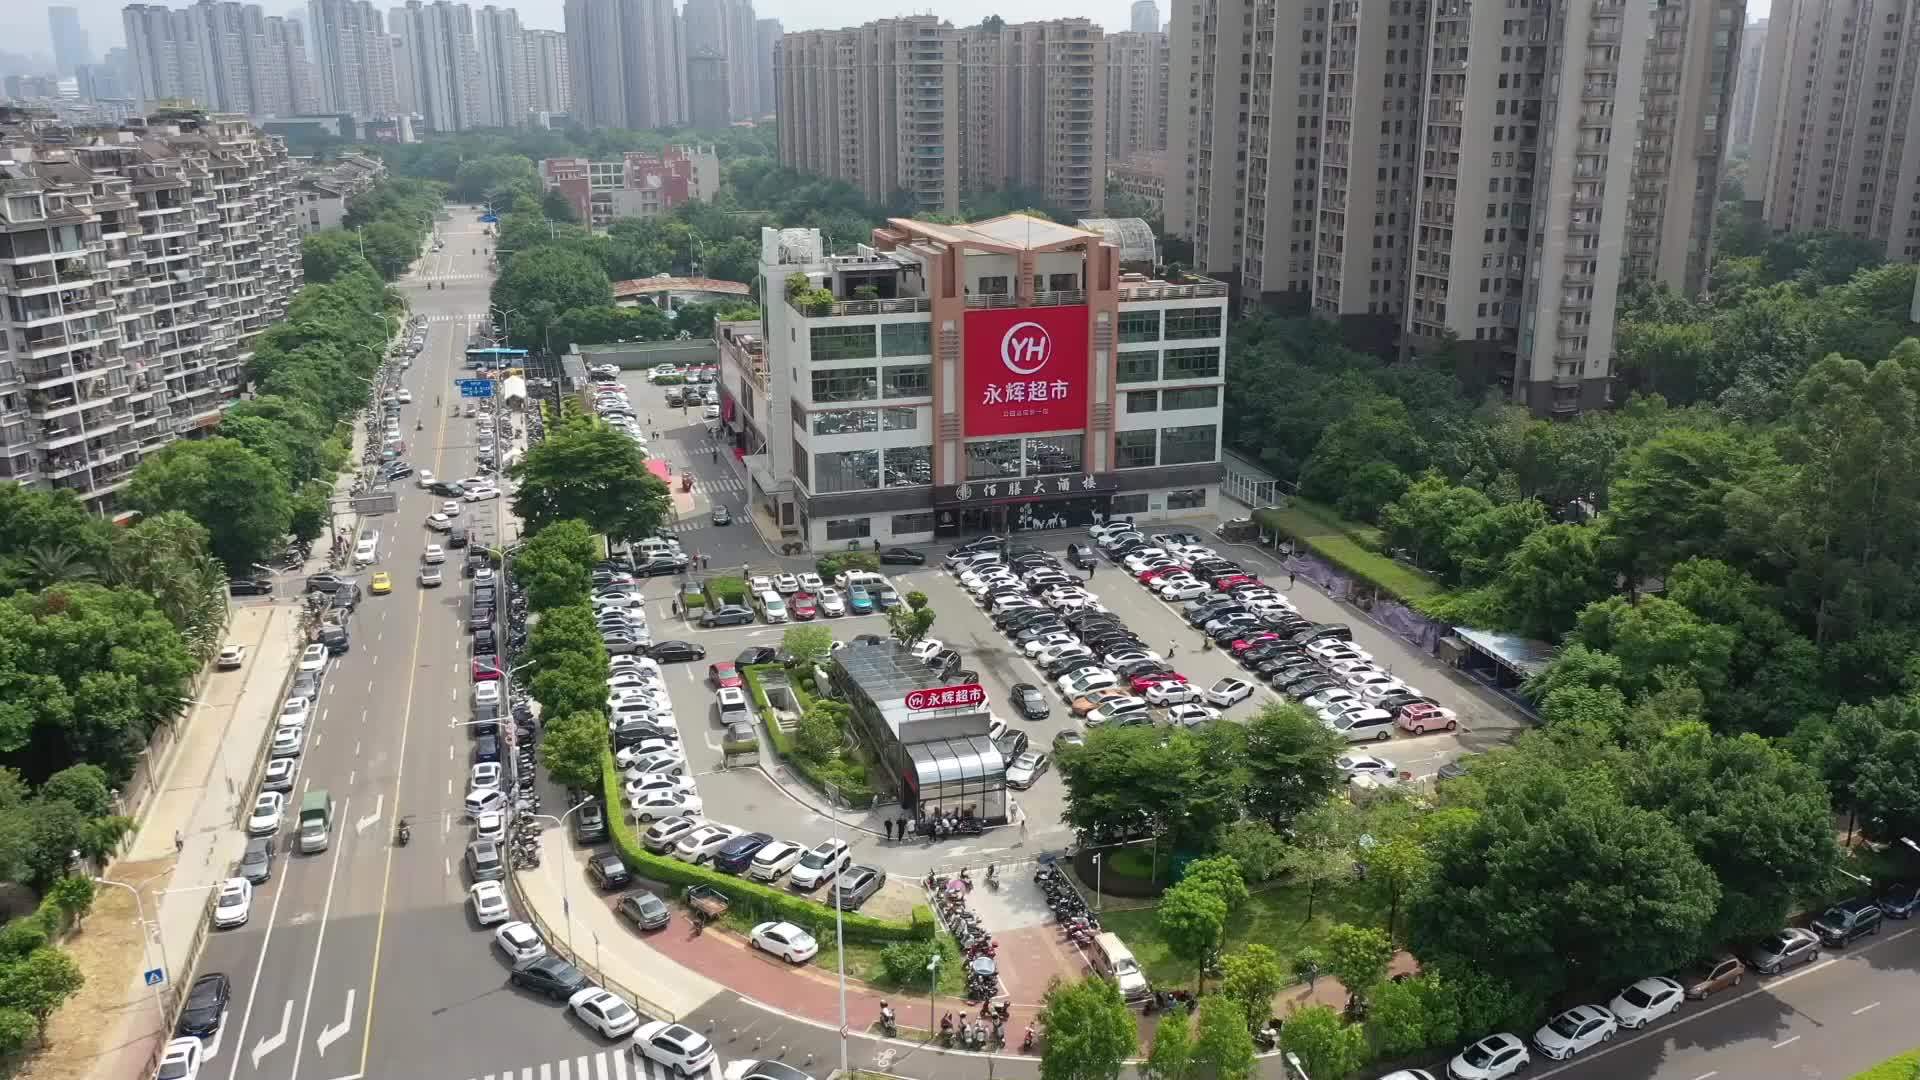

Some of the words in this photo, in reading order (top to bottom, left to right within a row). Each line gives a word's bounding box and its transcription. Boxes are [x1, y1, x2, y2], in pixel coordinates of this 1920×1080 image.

[1011, 336, 1046, 362] YH
[982, 379, 1069, 405] 永辉超市
[927, 688, 982, 706] 永辉超市
